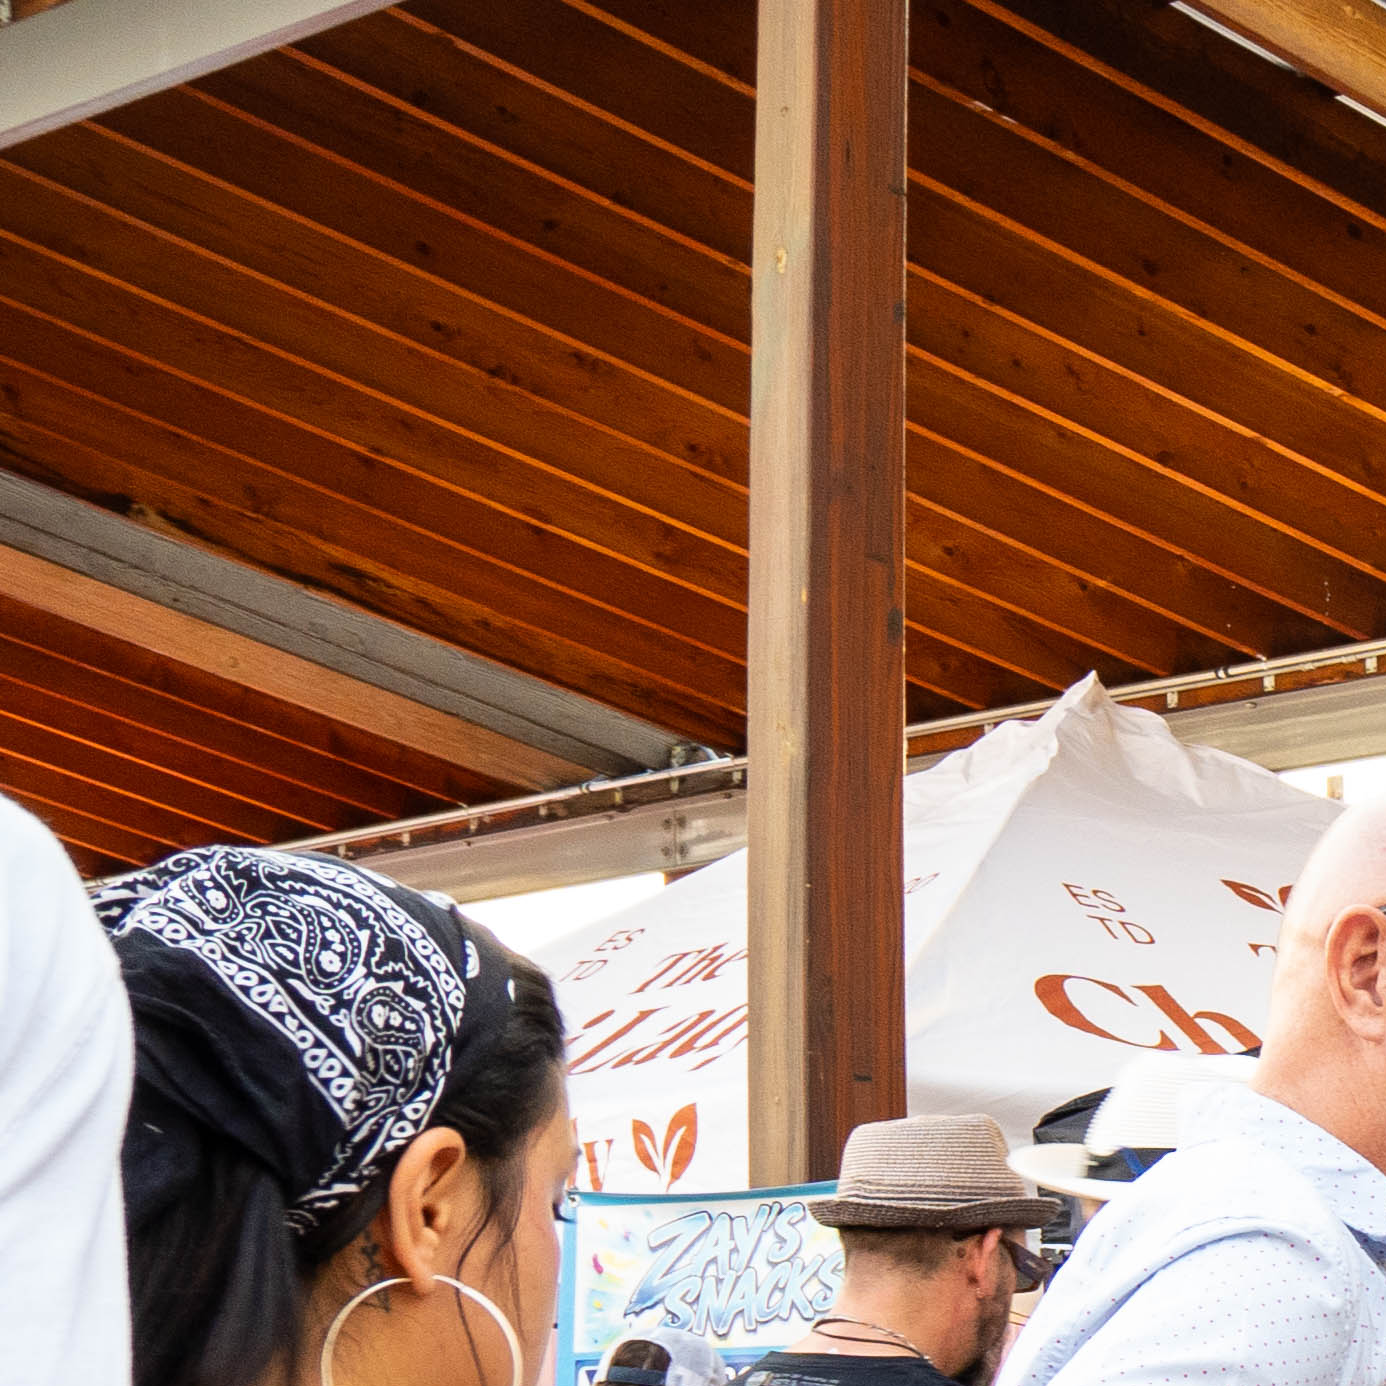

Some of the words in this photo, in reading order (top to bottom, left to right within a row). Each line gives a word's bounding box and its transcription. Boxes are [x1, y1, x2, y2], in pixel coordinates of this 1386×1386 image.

[1061, 882, 1126, 913] ES
[1086, 914, 1155, 944] TD
[1034, 974, 1263, 1055] Ch
[624, 1201, 806, 1317] ZAY'S
[660, 1252, 846, 1339] SNACKS
